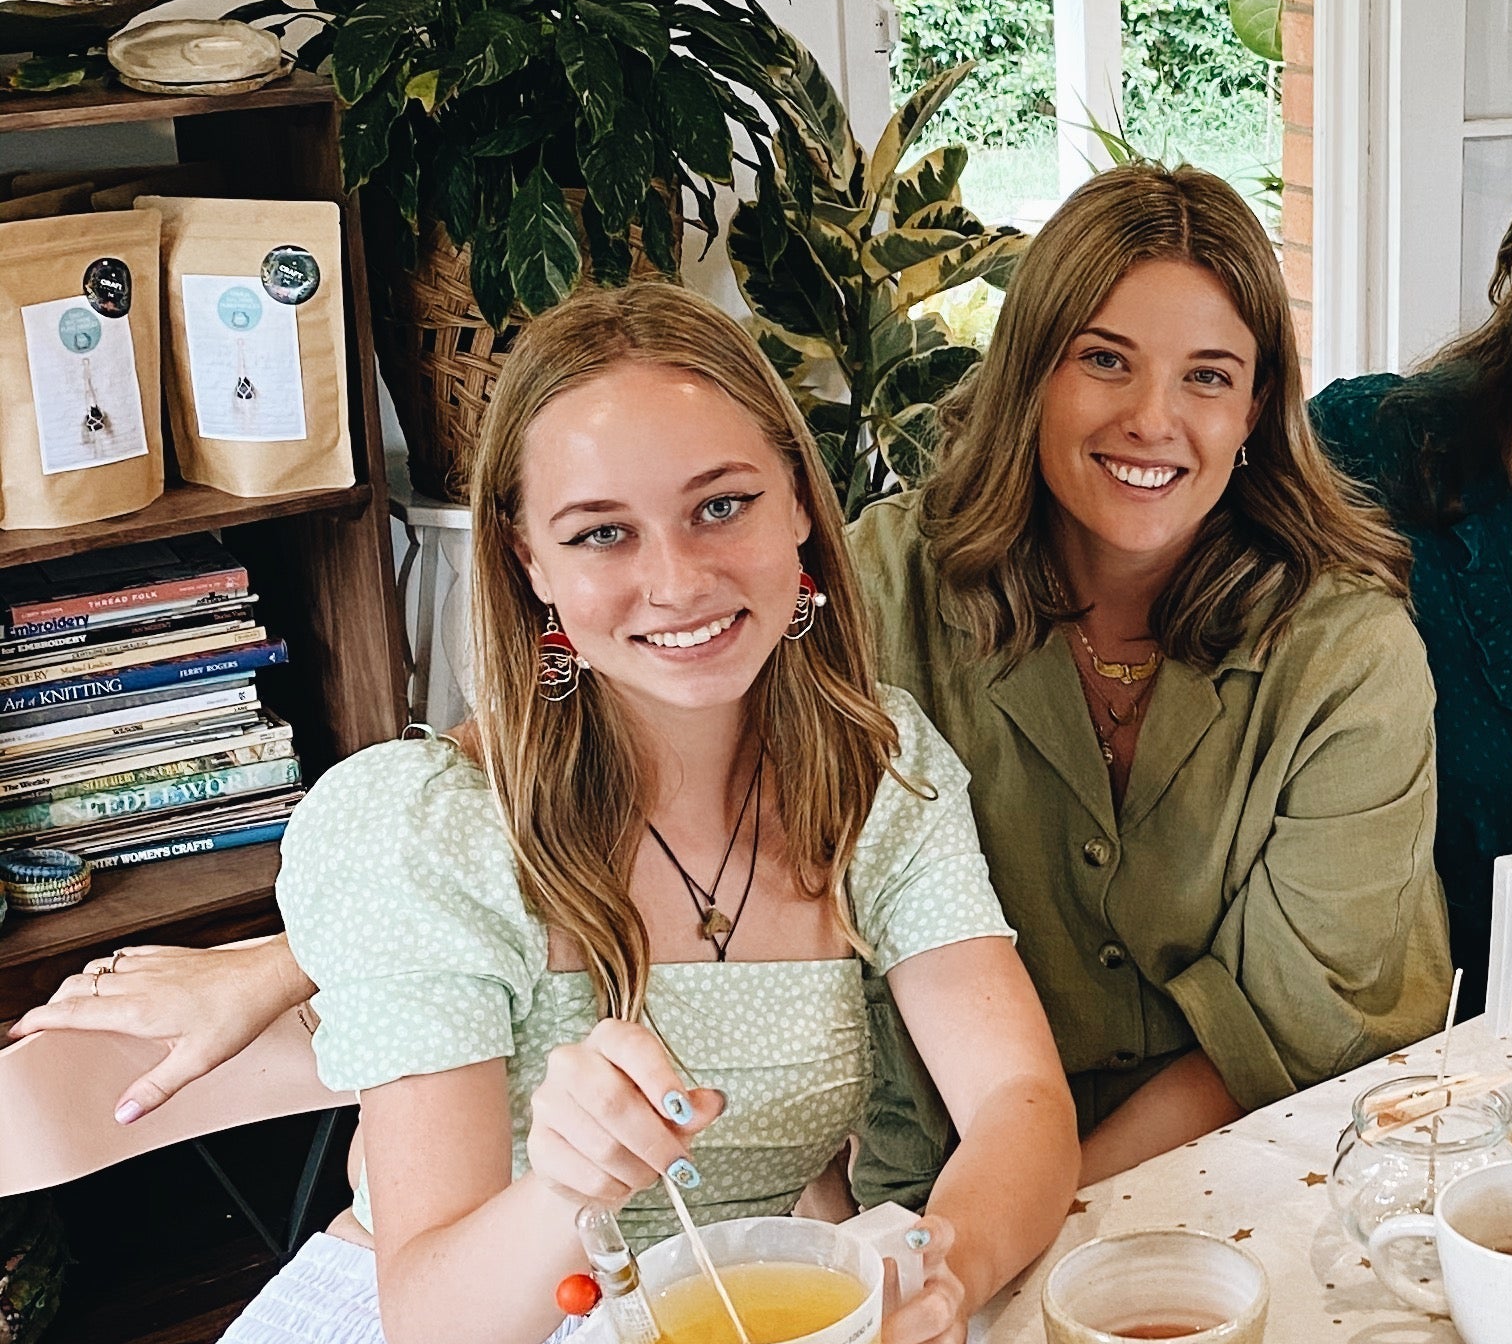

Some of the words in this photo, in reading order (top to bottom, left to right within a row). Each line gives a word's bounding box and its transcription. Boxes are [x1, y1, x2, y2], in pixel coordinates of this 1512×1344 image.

[88, 596, 129, 608] THREAD
[132, 591, 158, 601] FOLK
[17, 635, 87, 653] EMBROIDERY
[0, 670, 48, 687] ROIDERY
[3, 697, 24, 712] Art
[39, 678, 123, 705] KNITTING
[90, 856, 119, 869] NTRY
[120, 846, 171, 864] WOMEN'S
[172, 838, 214, 855] CRAFTS
